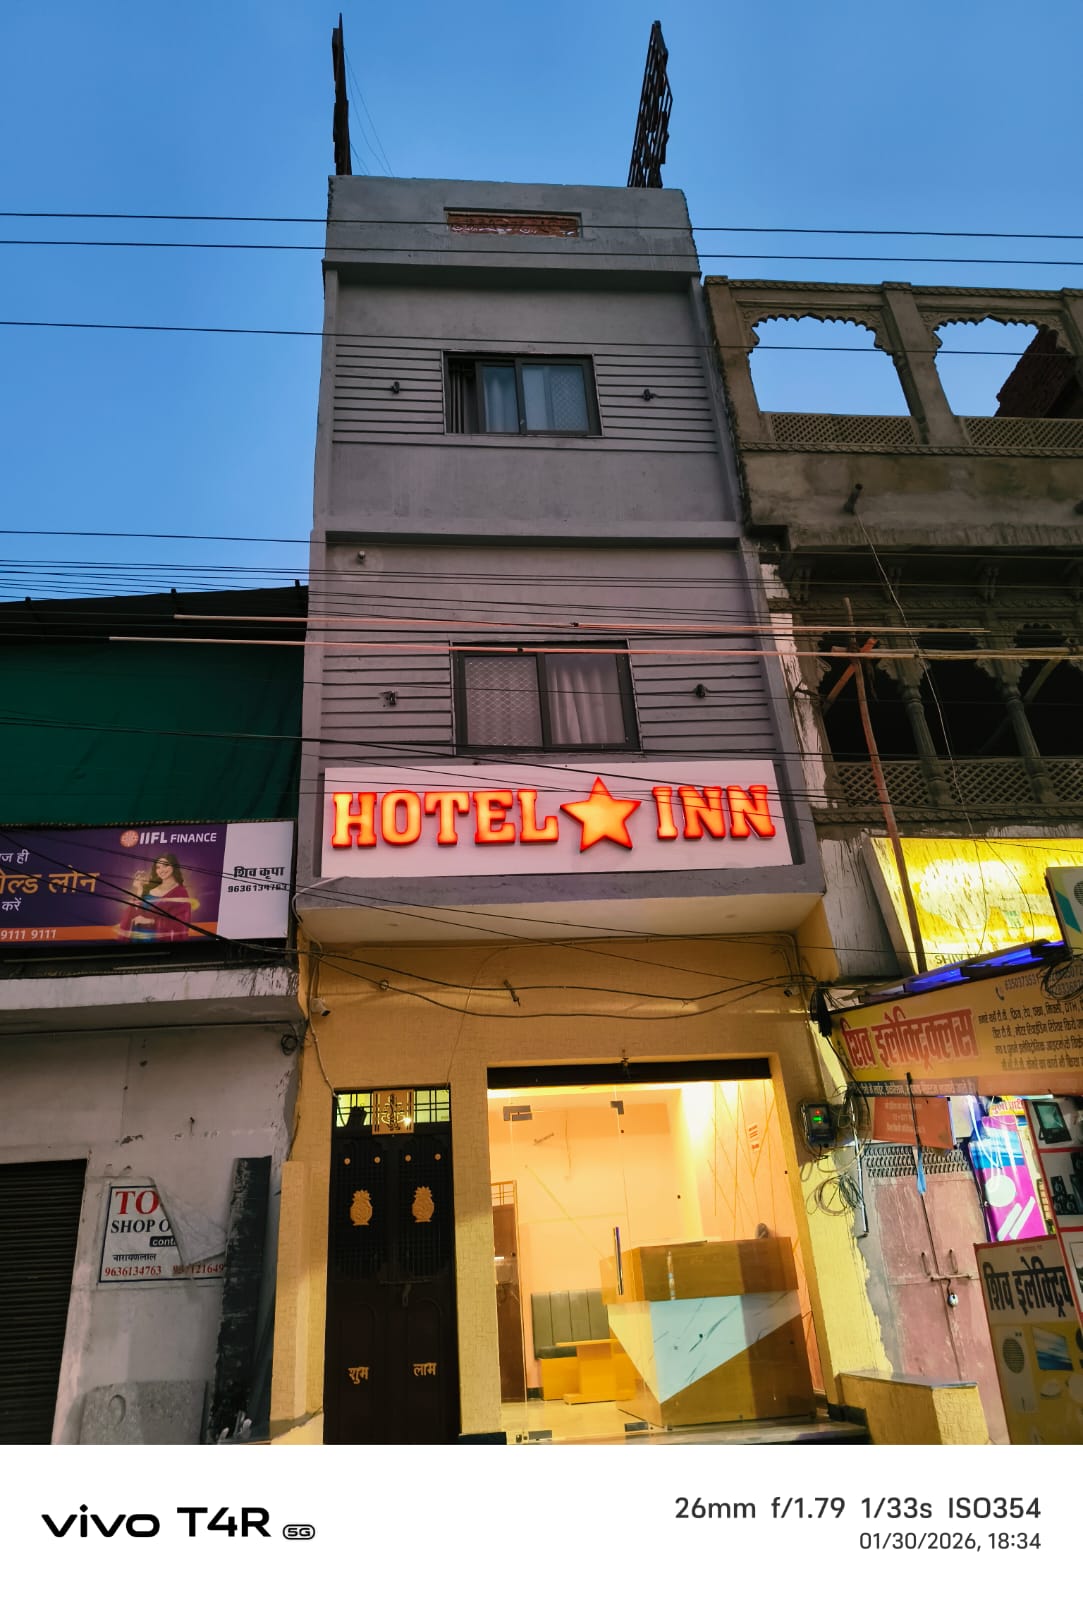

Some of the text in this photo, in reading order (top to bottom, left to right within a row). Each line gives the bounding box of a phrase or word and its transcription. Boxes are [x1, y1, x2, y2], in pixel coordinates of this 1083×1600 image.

[331, 784, 776, 848] HOTEL INN
[139, 831, 217, 845] IIFL FINANCE
[0, 848, 30, 864] ज ही
[0, 864, 100, 894] ोल्ड लोन
[233, 865, 286, 879] शिव कृपा
[2, 896, 22, 912] करें
[0, 929, 57, 941] 9111 9111
[839, 1016, 876, 1067] शिव
[110, 1218, 171, 1234] SHOP O
[104, 1265, 162, 1277] 9636134763
[983, 1261, 1014, 1310] शिव
